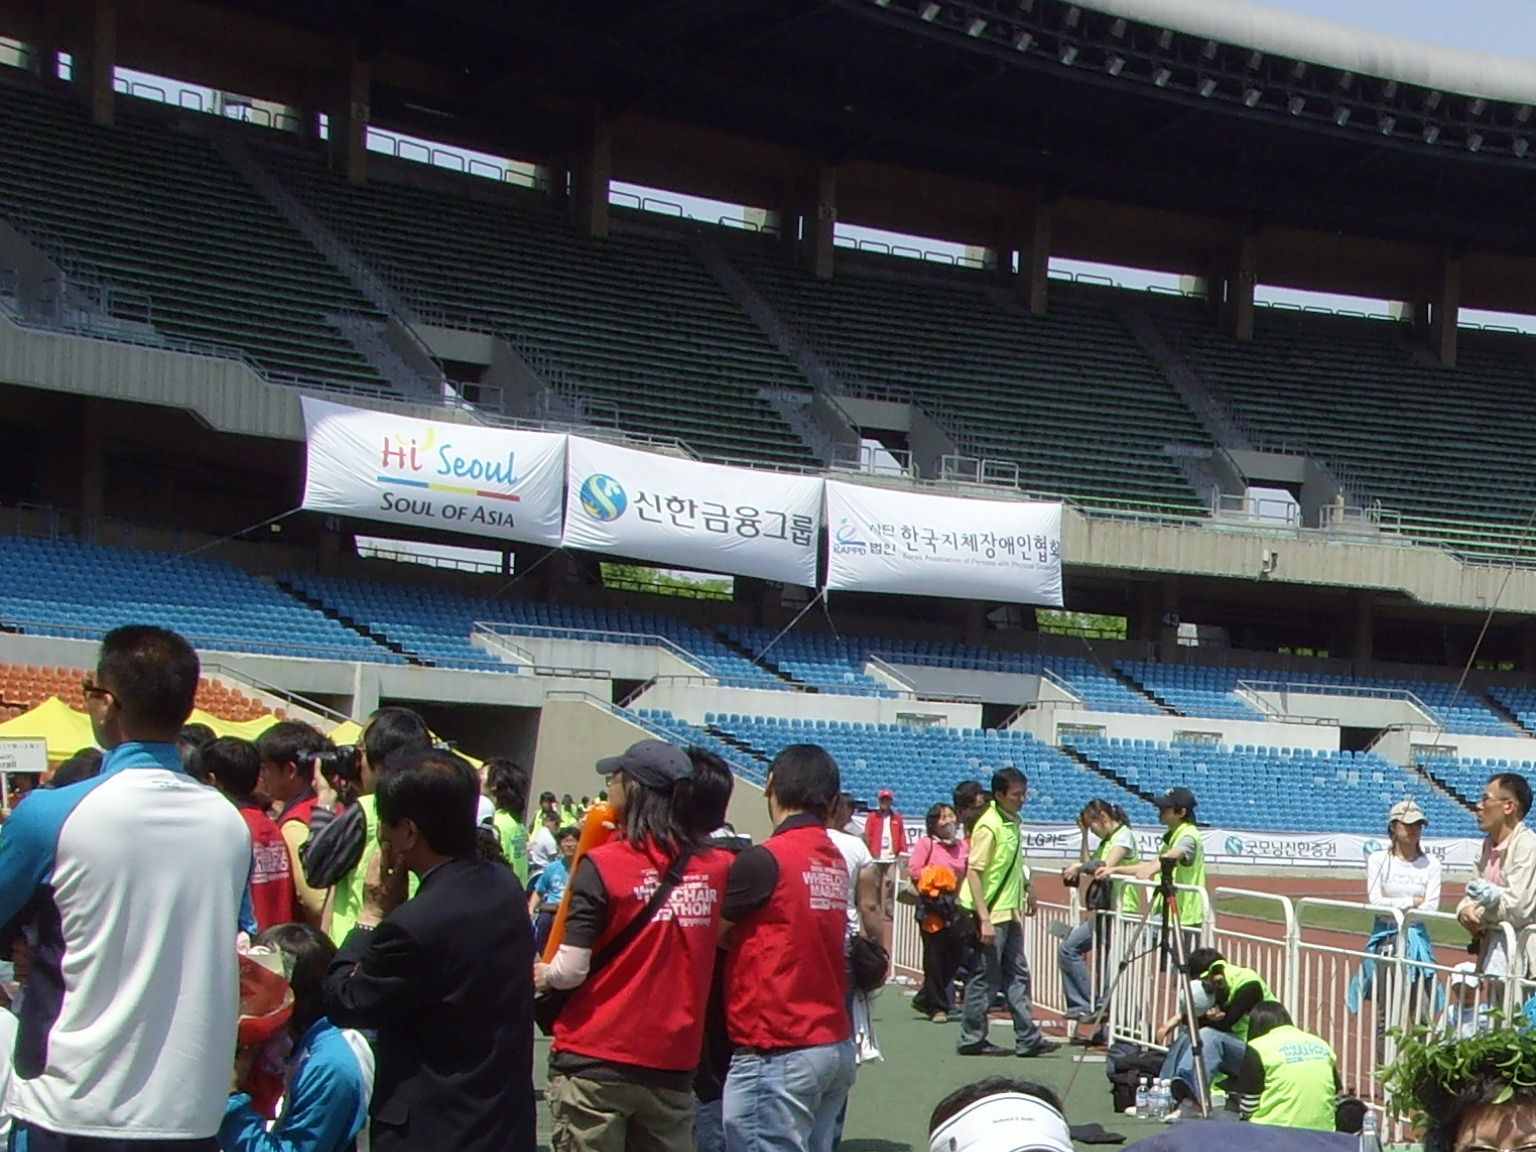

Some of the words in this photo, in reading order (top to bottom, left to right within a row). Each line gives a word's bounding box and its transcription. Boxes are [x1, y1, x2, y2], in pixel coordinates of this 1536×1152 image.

[436, 443, 517, 486] Seoul
[380, 492, 433, 518] SOUL
[442, 505, 468, 521] OF
[470, 505, 515, 529] ASIA
[632, 489, 813, 547] 신한금융그룹
